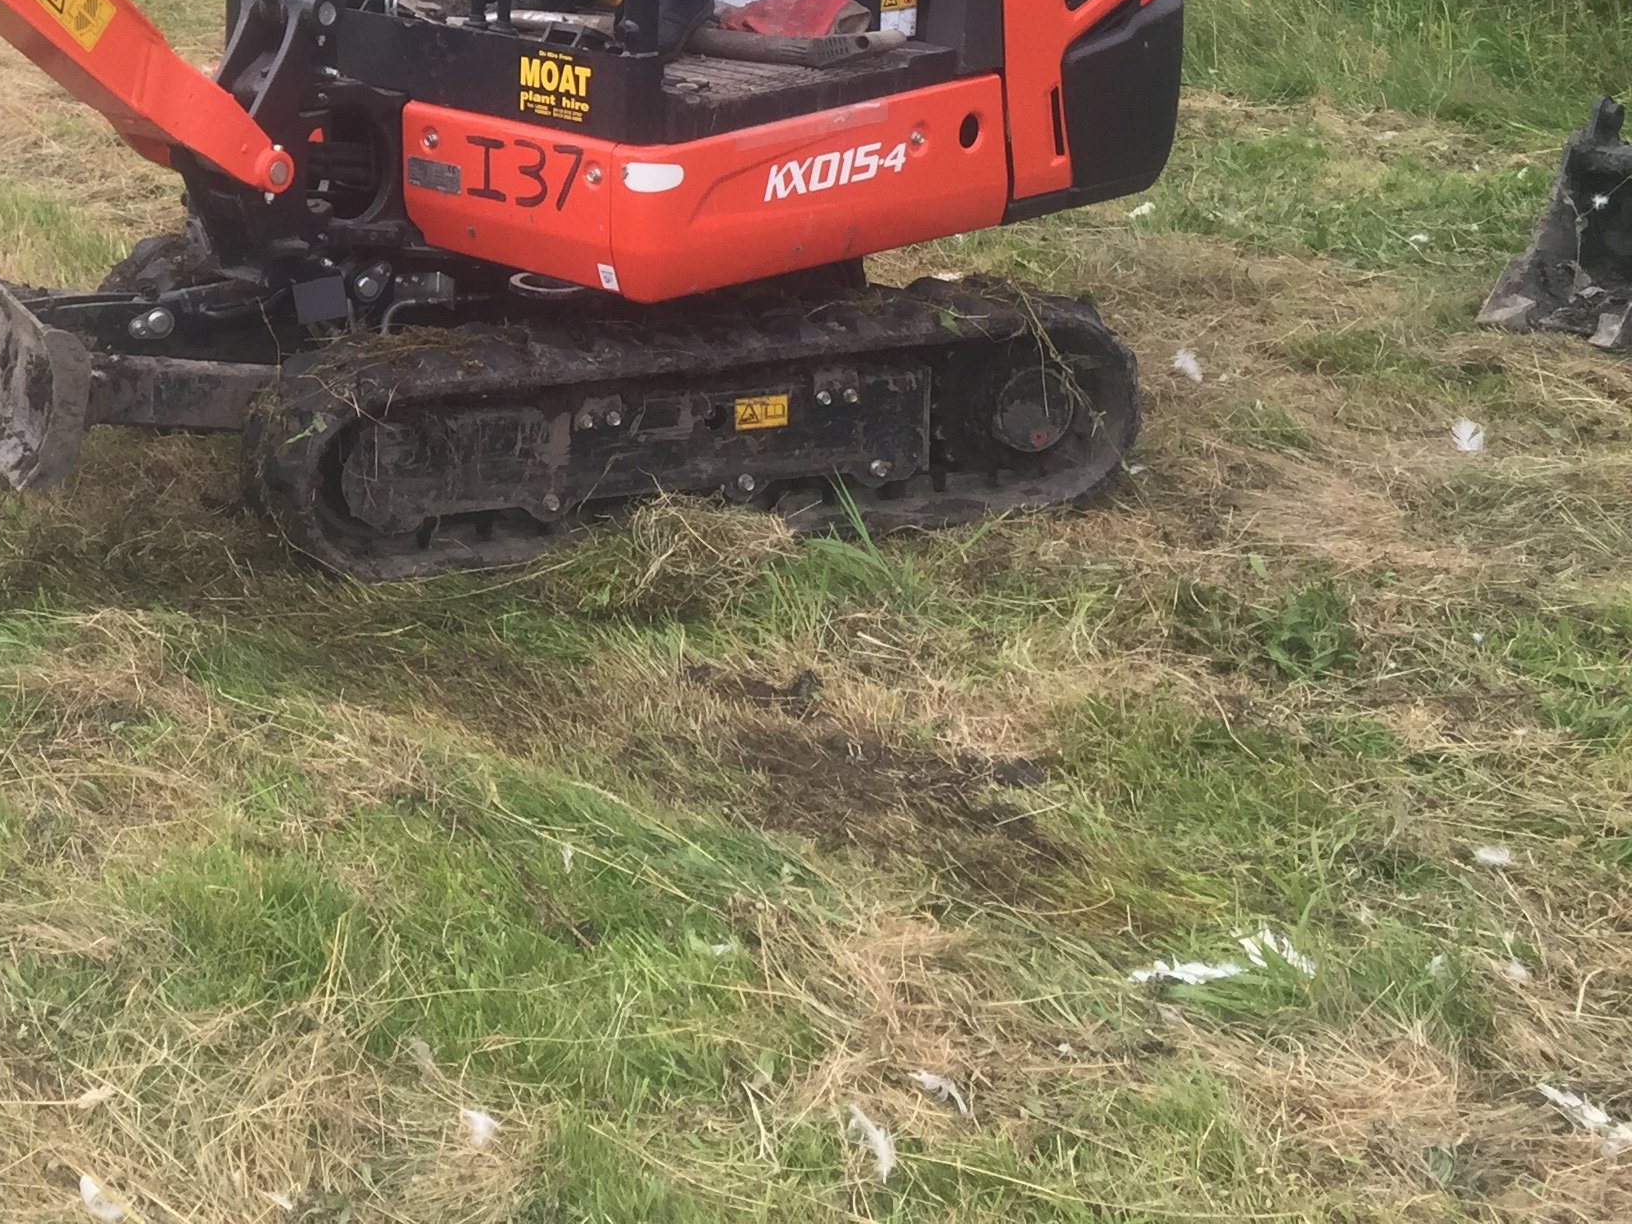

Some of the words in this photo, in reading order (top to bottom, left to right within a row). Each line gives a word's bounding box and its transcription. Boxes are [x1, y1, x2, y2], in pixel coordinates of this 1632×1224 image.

[520, 56, 592, 97] MOAT
[520, 90, 556, 111] plant
[561, 96, 590, 112] hire
